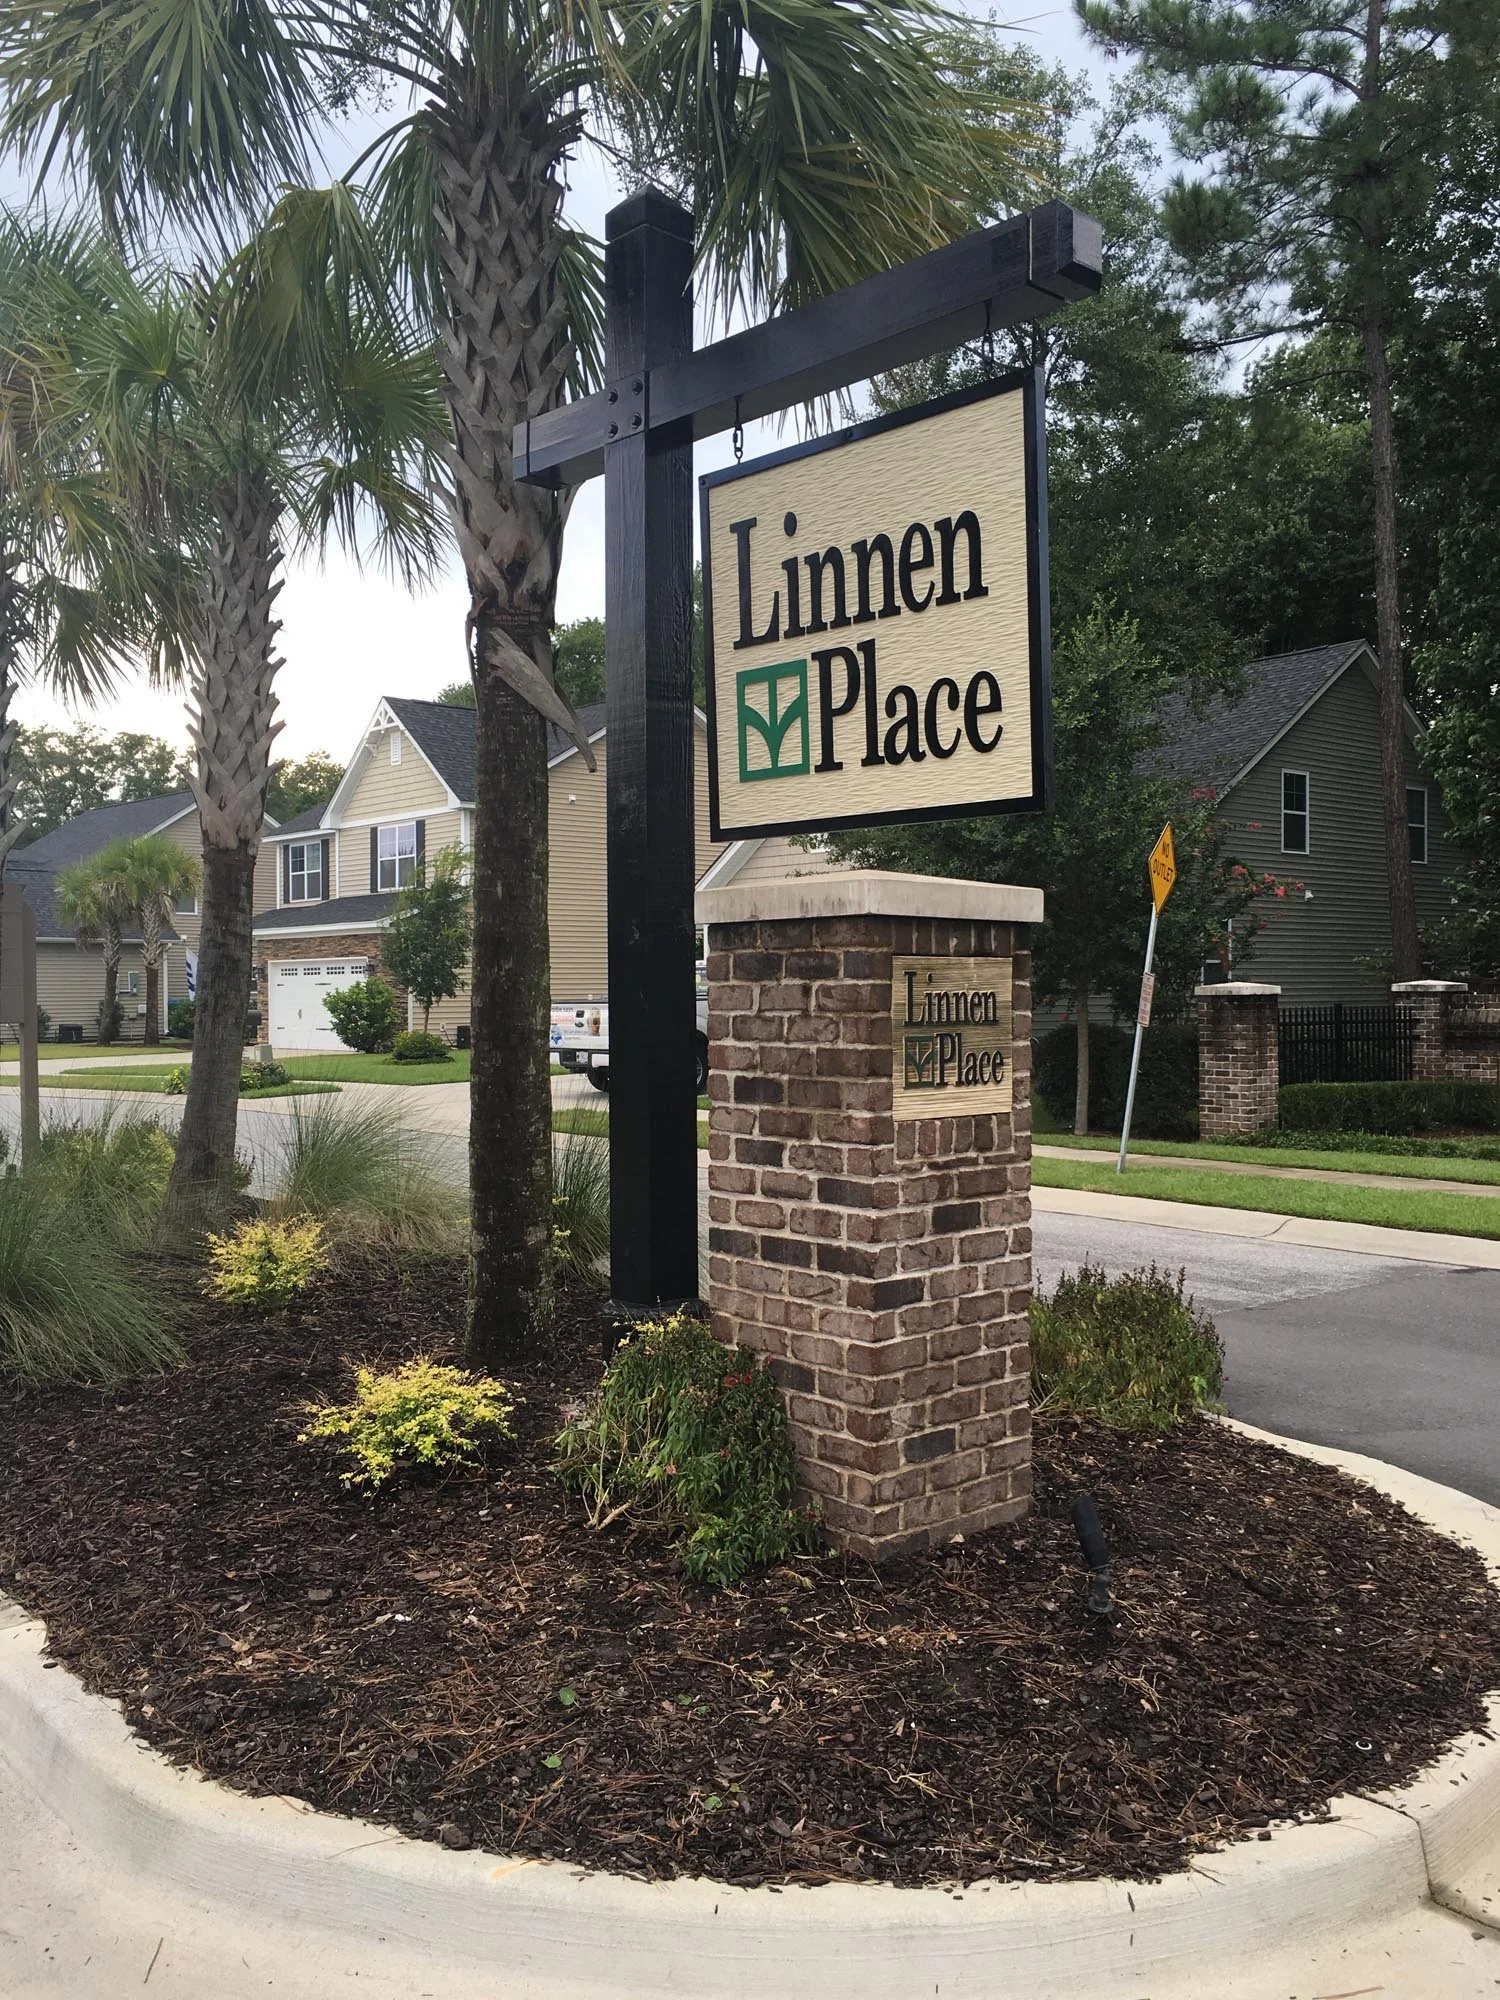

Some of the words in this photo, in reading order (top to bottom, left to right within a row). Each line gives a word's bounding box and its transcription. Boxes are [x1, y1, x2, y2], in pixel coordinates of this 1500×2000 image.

[730, 510, 989, 649] Linnen
[811, 638, 1004, 773] Place
[1152, 858, 1174, 883] OUTLET
[1162, 841, 1170, 858] NO
[903, 970, 999, 1026] Linnen
[934, 1032, 1005, 1087] Place
